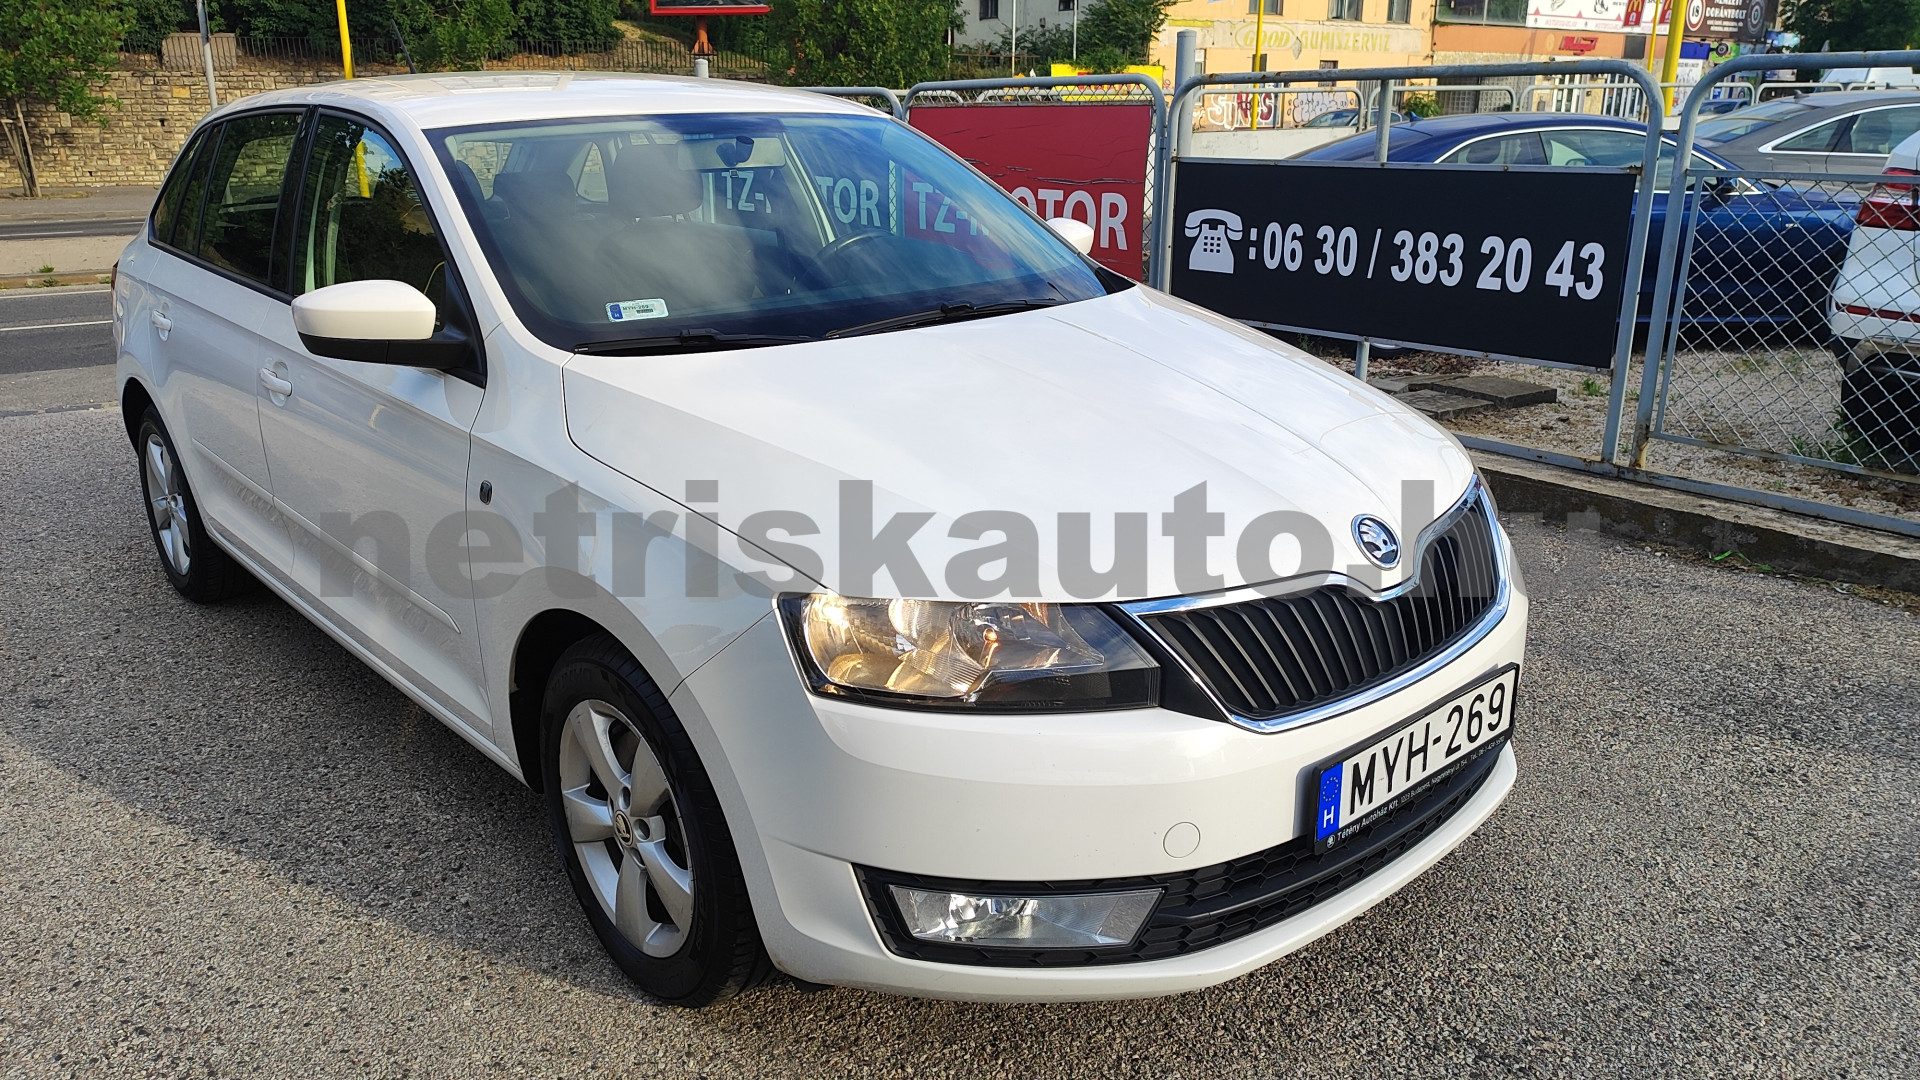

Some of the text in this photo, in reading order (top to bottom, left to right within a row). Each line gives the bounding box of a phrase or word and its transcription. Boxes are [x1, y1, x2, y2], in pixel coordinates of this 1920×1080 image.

[1243, 29, 1391, 51] GOOD GUMISZERVIZ
[1314, 225, 1358, 277] 30
[1390, 230, 1464, 287] 383
[1476, 235, 1532, 293] 20
[1545, 240, 1605, 300] 43
[1323, 682, 1506, 829] H MYH-269
